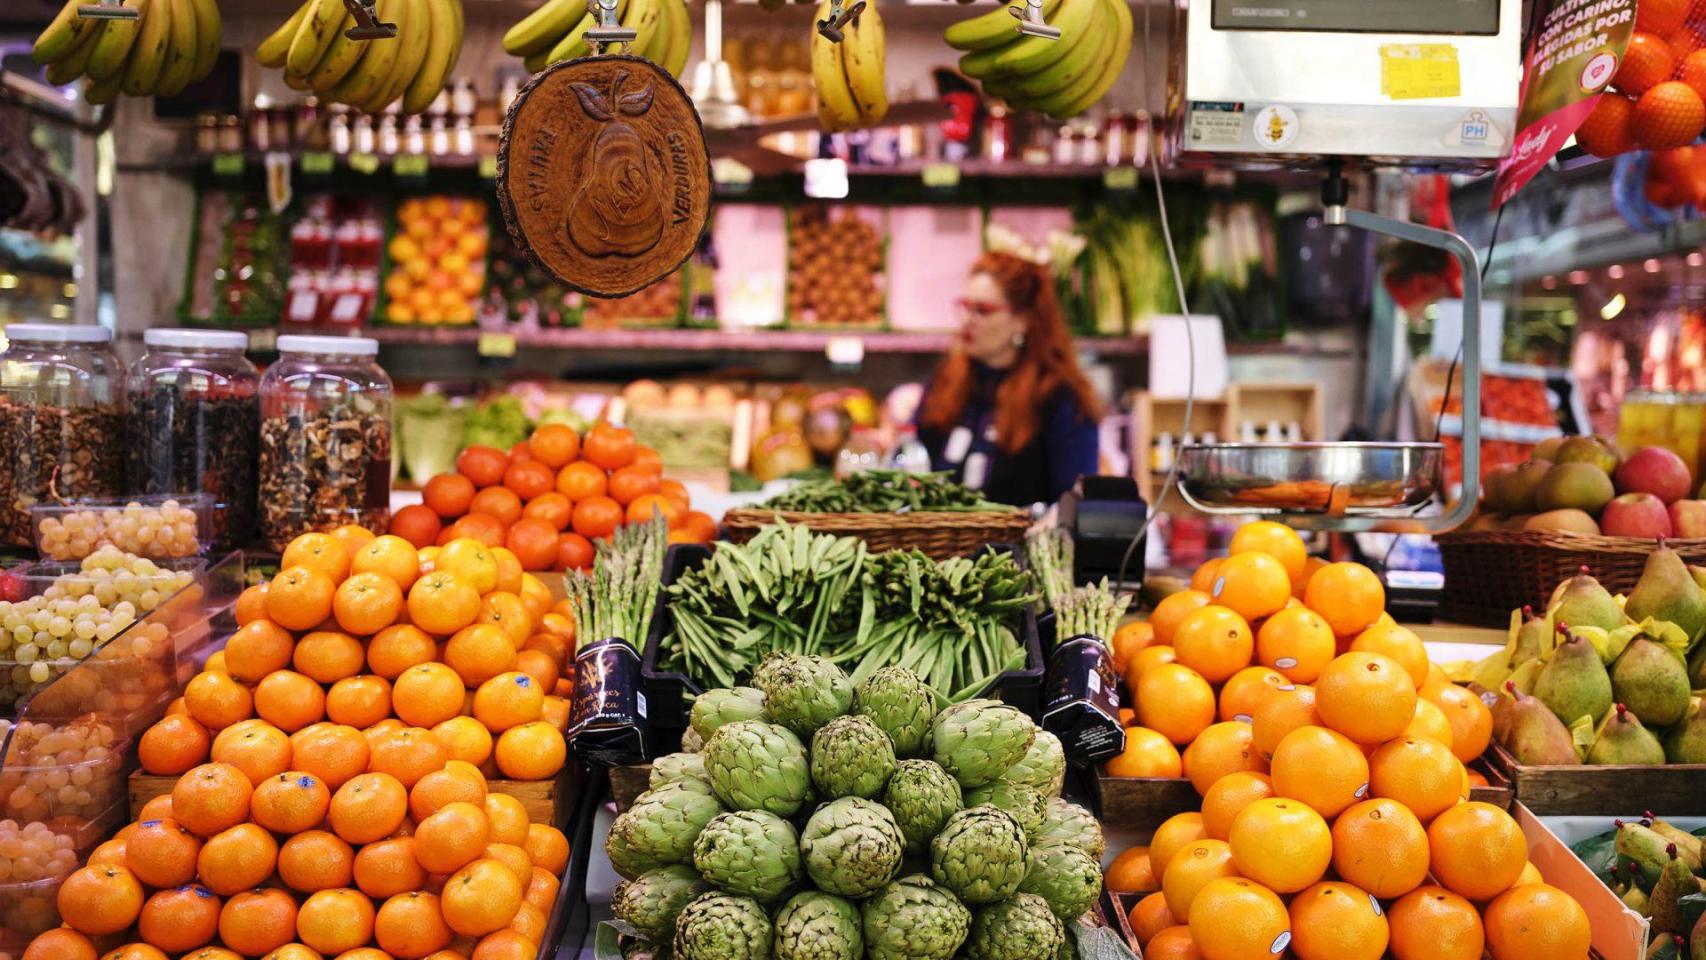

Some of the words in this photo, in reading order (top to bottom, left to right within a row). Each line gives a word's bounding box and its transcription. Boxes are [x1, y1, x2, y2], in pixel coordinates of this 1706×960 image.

[1538, 20, 1563, 47] CON
[1594, 9, 1632, 31] POR
[1539, 56, 1556, 77] SU
[1556, 33, 1608, 65] SABOR
[1465, 124, 1484, 136] PH
[665, 132, 691, 226] VERDURAS
